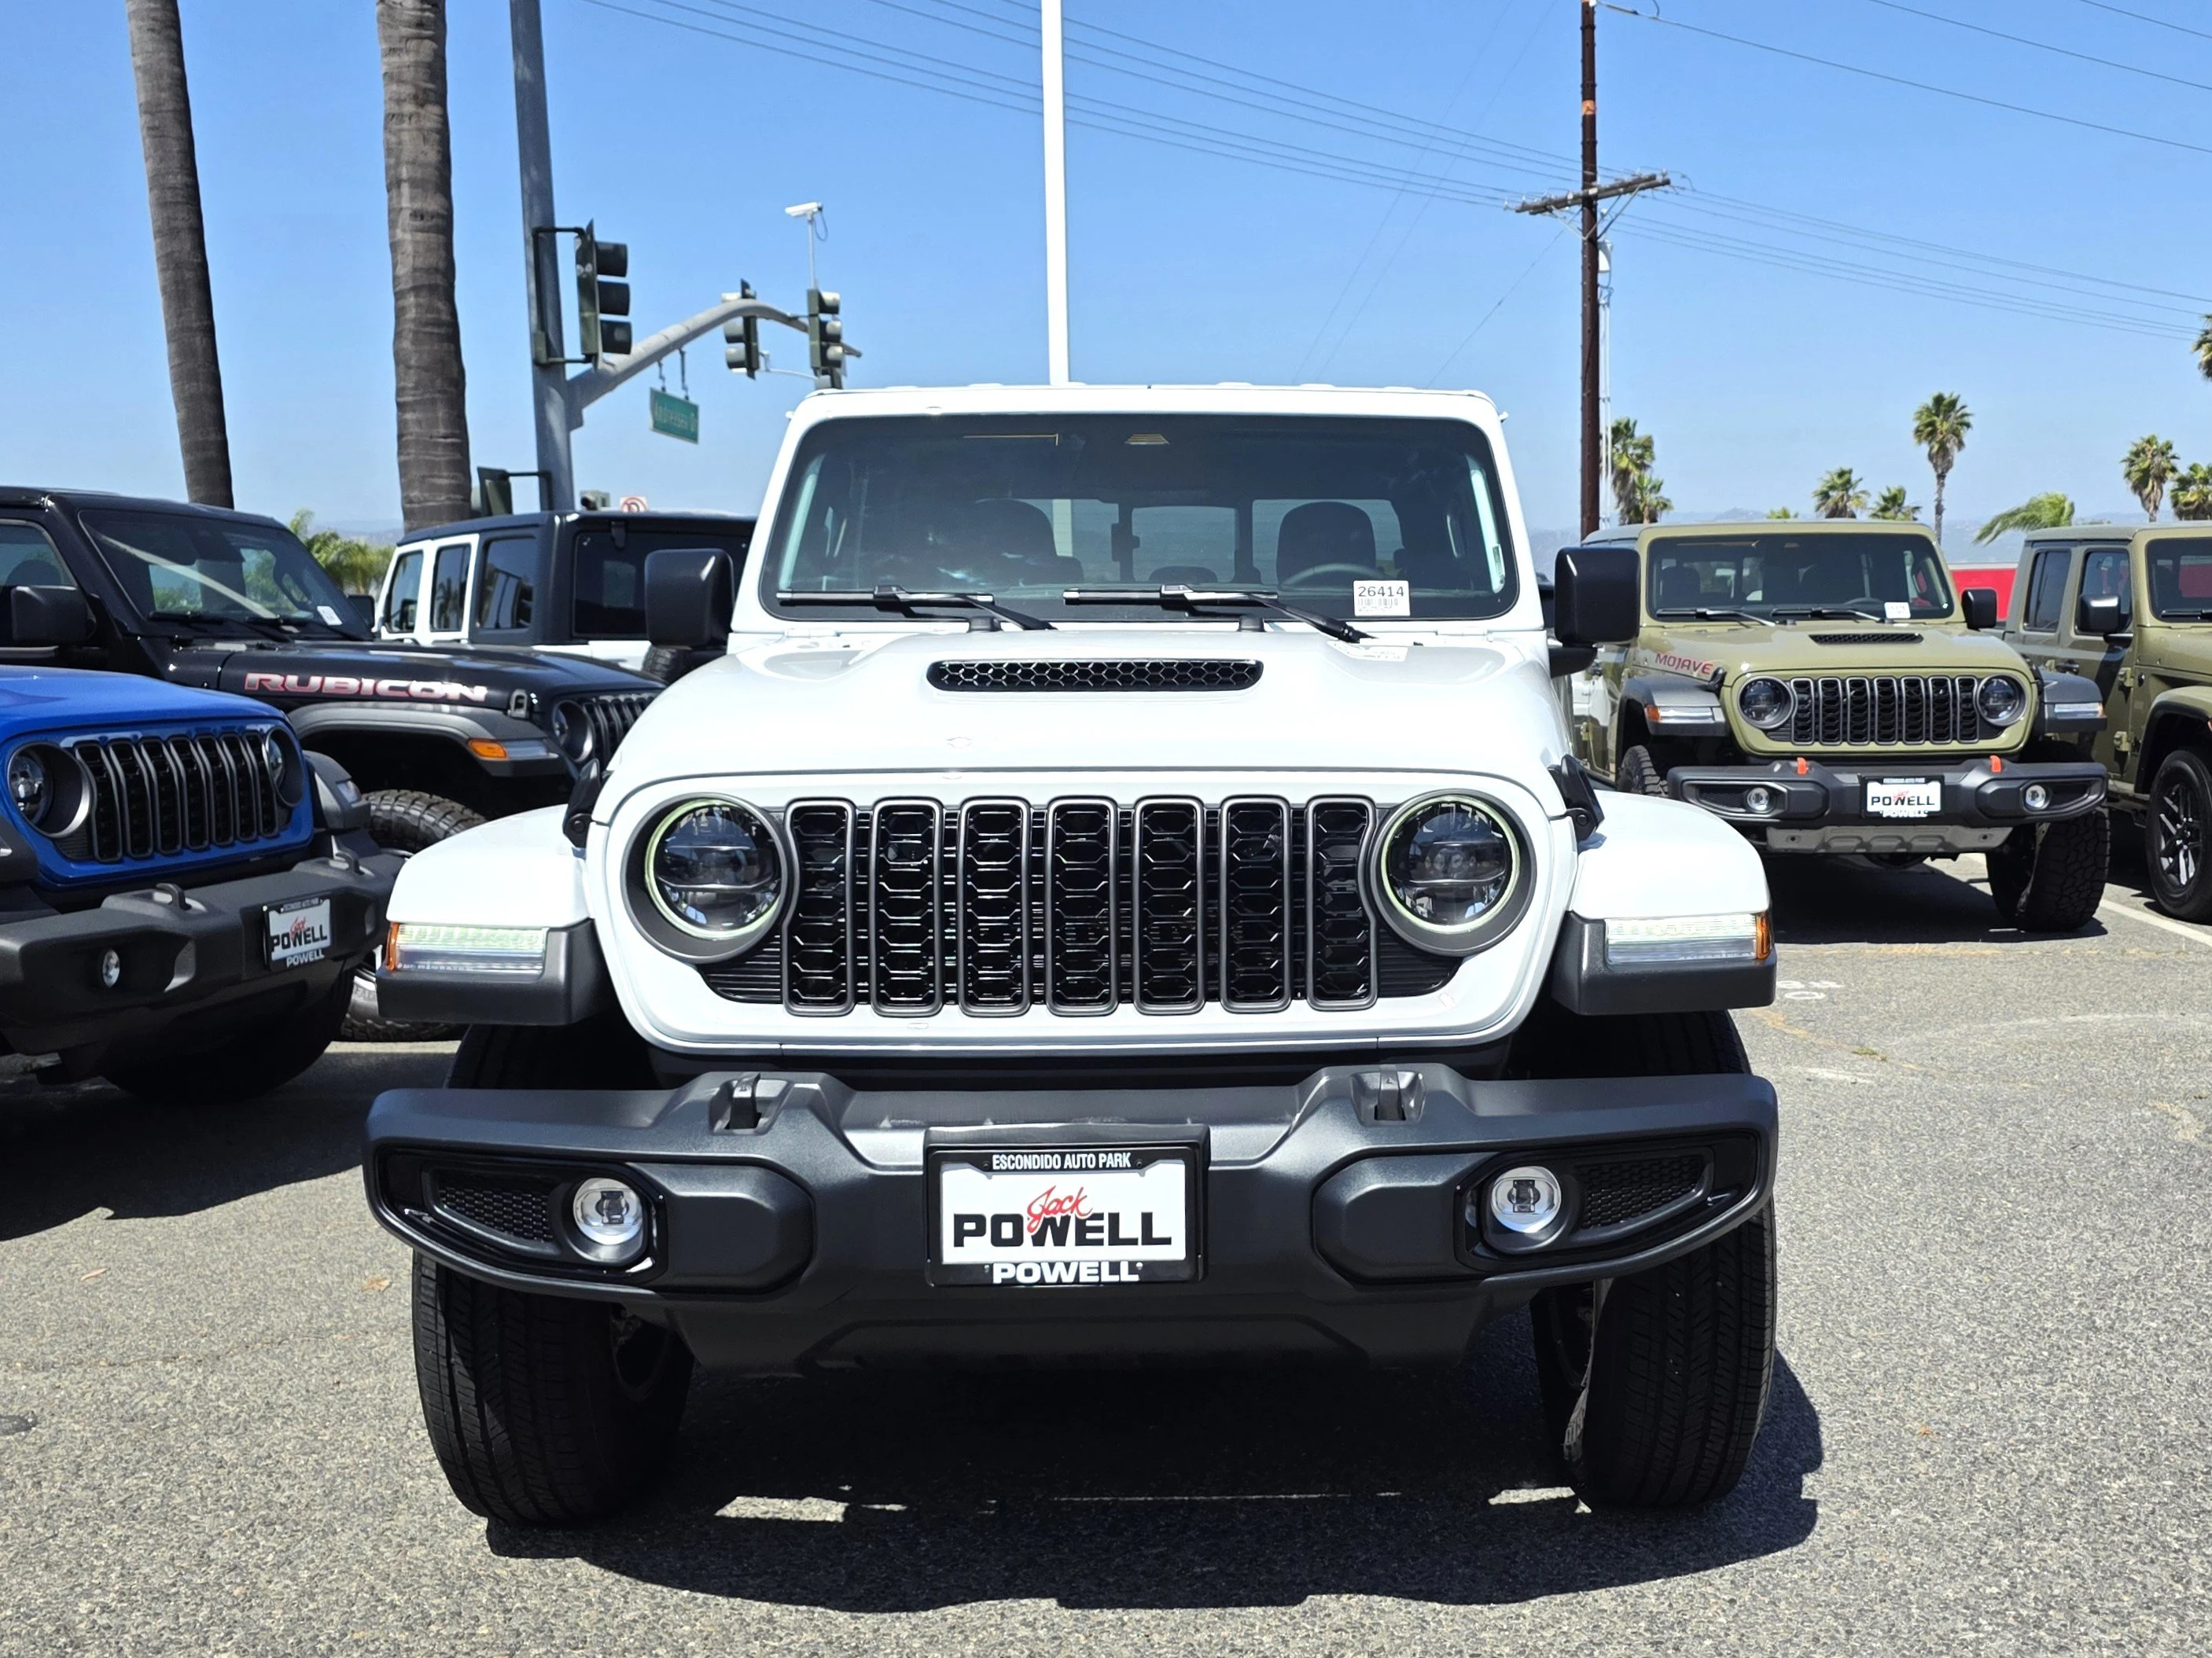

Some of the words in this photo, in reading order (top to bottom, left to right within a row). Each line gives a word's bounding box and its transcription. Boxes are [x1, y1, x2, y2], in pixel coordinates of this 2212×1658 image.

[1357, 586, 1404, 597] 26414
[1654, 653, 1713, 675] MOJAVE
[244, 672, 488, 702] RUBICON
[1871, 796, 1935, 806] POWELL
[271, 924, 328, 953] POWELL
[285, 948, 325, 968] POWELL
[992, 1154, 1062, 1170] ESCONDIDO
[1063, 1153, 1096, 1169] AUTO
[1099, 1153, 1131, 1168] PARK
[1027, 1185, 1092, 1233] Jack
[953, 1211, 1172, 1248] POWELL
[992, 1261, 1139, 1284] POWELL
